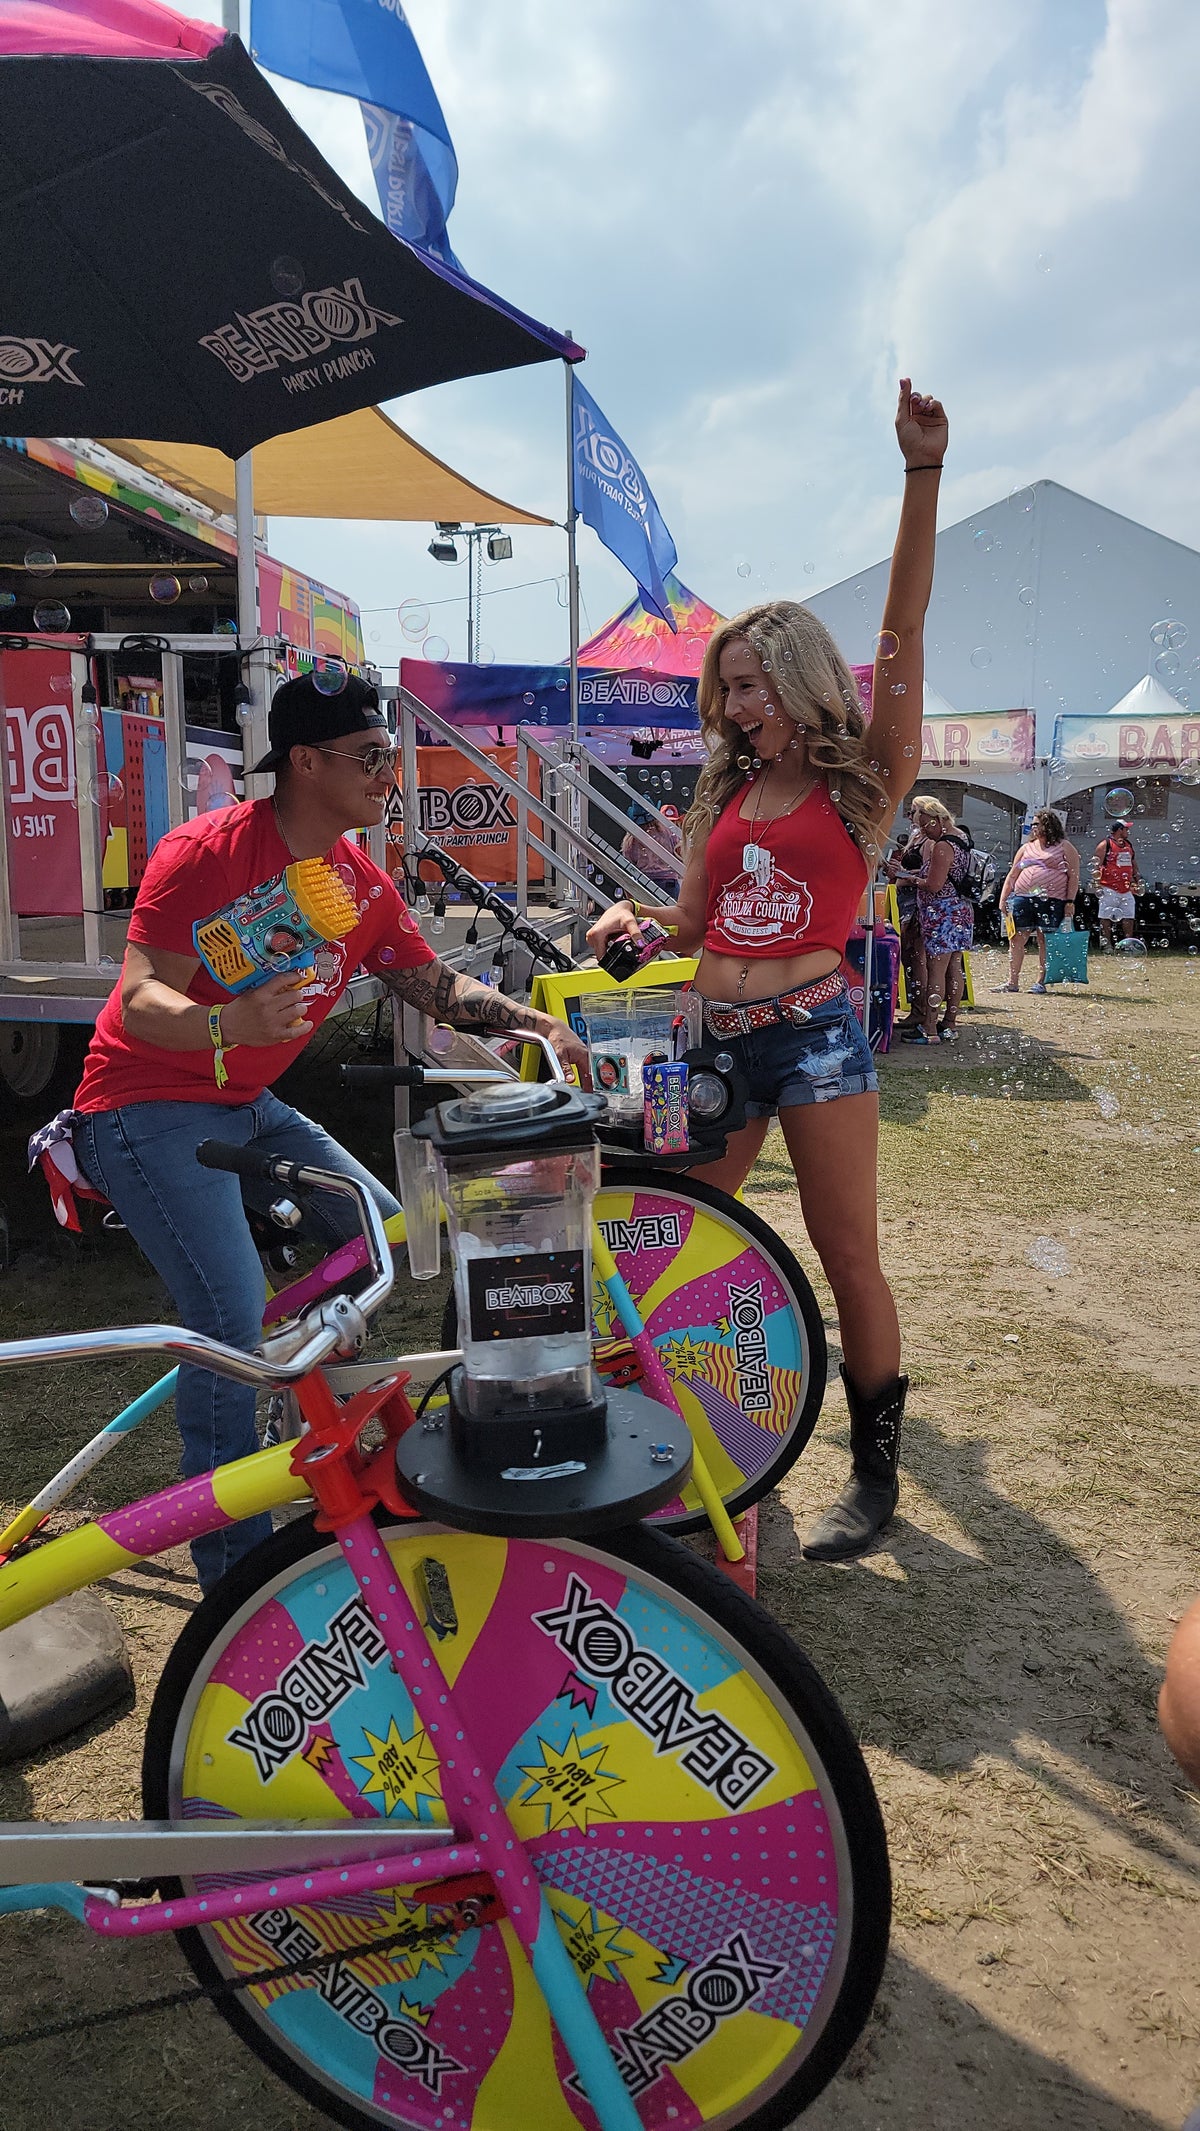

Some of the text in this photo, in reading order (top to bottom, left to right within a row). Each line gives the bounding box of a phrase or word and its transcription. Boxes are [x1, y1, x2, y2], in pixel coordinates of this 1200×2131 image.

[198, 278, 405, 383] BEATBOX
[281, 347, 376, 395] PARTY PUNCH
[579, 676, 690, 708] BEATBOX
[921, 723, 970, 768] AR
[385, 783, 518, 832] ATBOX
[446, 834, 476, 847] PARTY
[475, 831, 509, 844] PUNCH
[731, 924, 769, 935] MUSIC FEST
[755, 901, 801, 923] COUNTRY
[668, 1076, 681, 1132] BEATBOX
[597, 1213, 681, 1256] BEAT
[485, 1281, 573, 1310] BEATBOX
[675, 1346, 686, 1369] 11.1%
[728, 1279, 772, 1412] BEATBOX
[229, 1592, 389, 1785] EATBOX
[532, 1573, 780, 1814] BEATBOX
[383, 1755, 418, 1800] 11.1%
[539, 1766, 586, 1806] 11.1%
[563, 1928, 788, 2103] EATBOX
